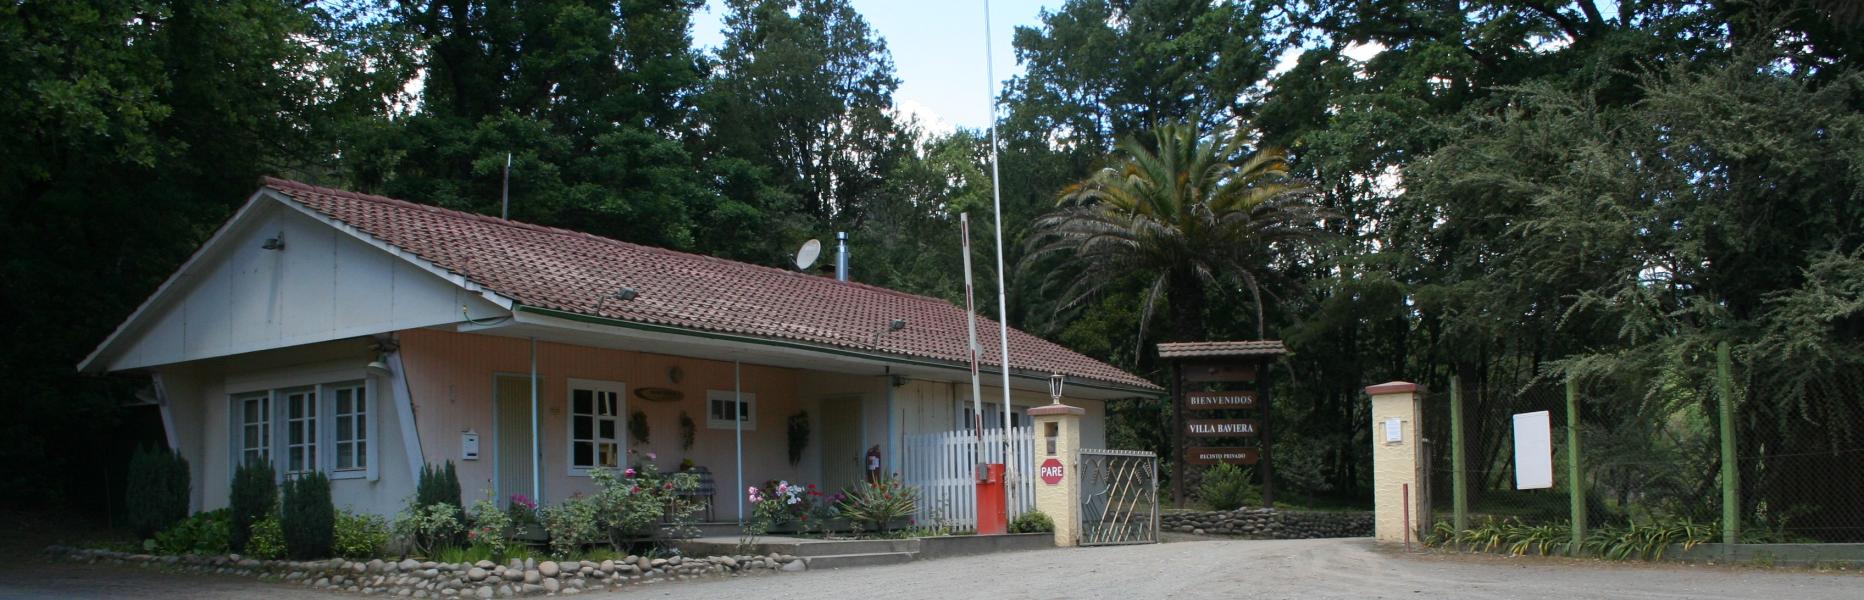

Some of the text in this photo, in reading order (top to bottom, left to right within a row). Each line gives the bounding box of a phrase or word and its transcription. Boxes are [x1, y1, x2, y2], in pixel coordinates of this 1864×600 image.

[1190, 396, 1253, 405] BIENVENIDOS
[1189, 424, 1254, 433] VILLA BAVIERA
[1041, 466, 1063, 477] PARE
